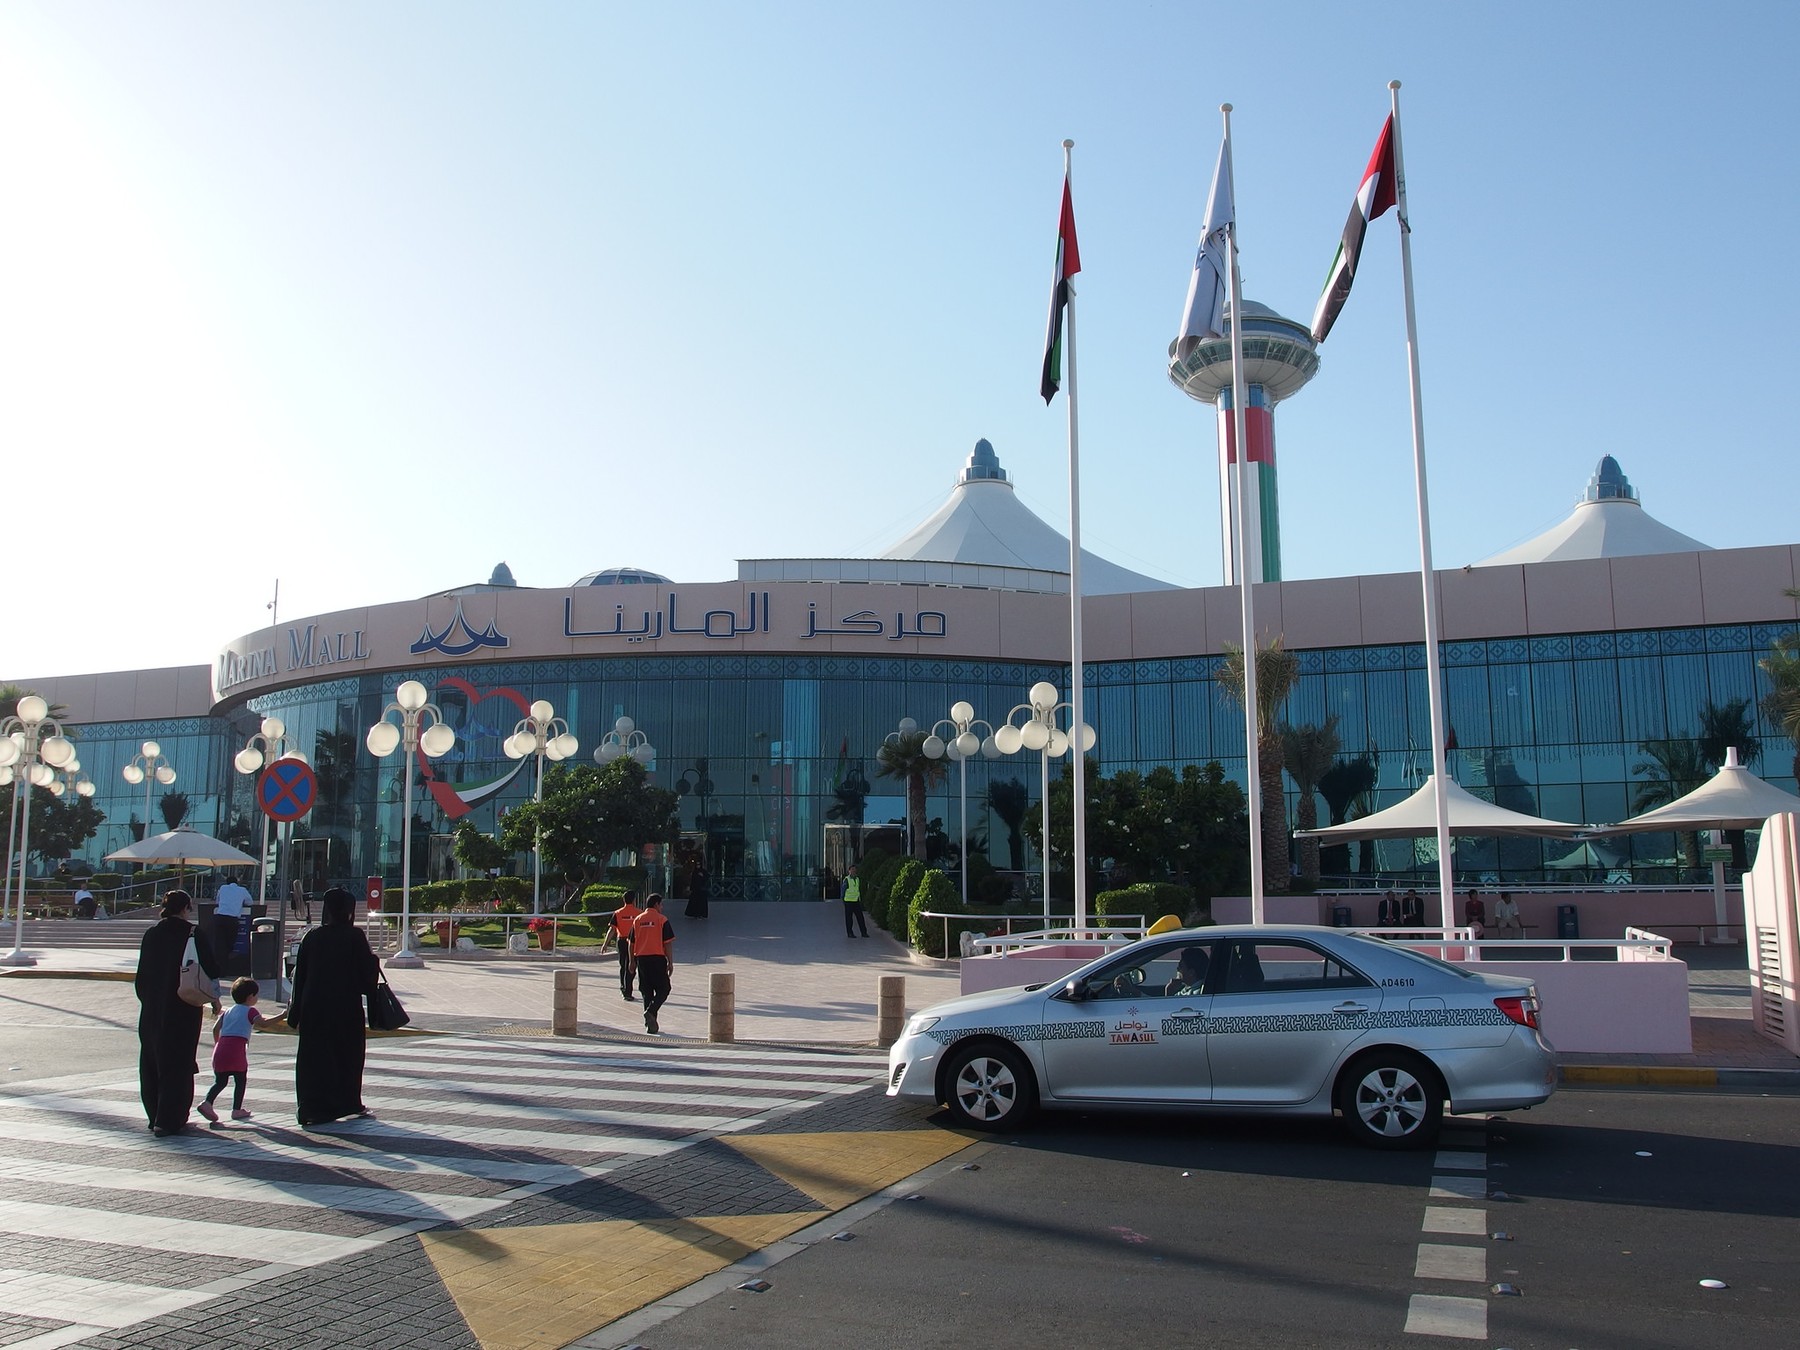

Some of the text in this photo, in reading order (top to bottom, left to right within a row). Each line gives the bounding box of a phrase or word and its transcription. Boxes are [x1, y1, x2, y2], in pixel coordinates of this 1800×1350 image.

[563, 591, 948, 643] مركز المارينا
[217, 623, 371, 692] MARINA MALL
[1381, 978, 1415, 987] AD4610
[1114, 1020, 1148, 1031] تواصل
[1111, 1033, 1156, 1043] TAWASUL
